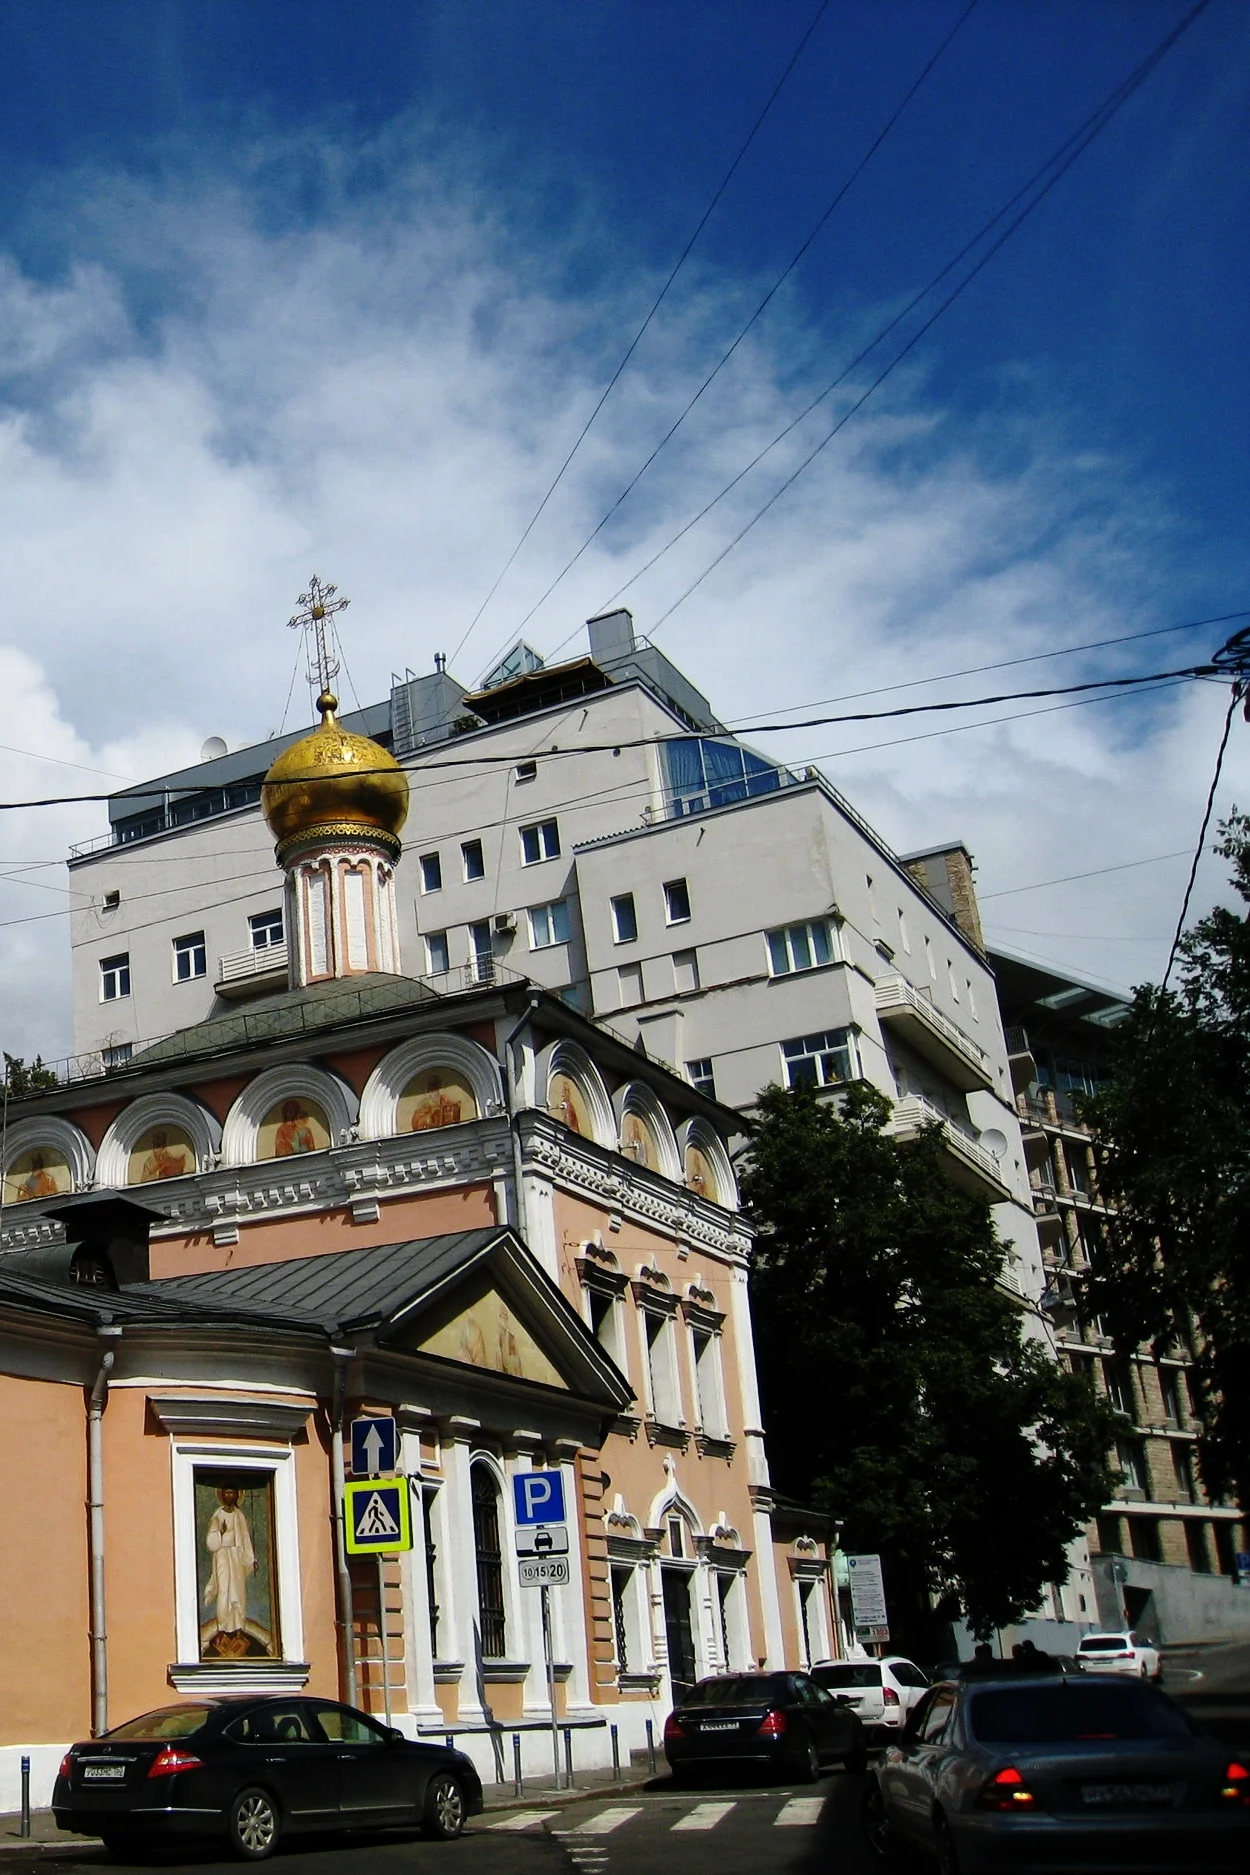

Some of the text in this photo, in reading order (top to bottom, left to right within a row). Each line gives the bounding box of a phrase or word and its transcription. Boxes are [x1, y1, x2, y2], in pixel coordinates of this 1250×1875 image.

[523, 1477, 552, 1518] P
[524, 1564, 564, 1578] 10 15 20
